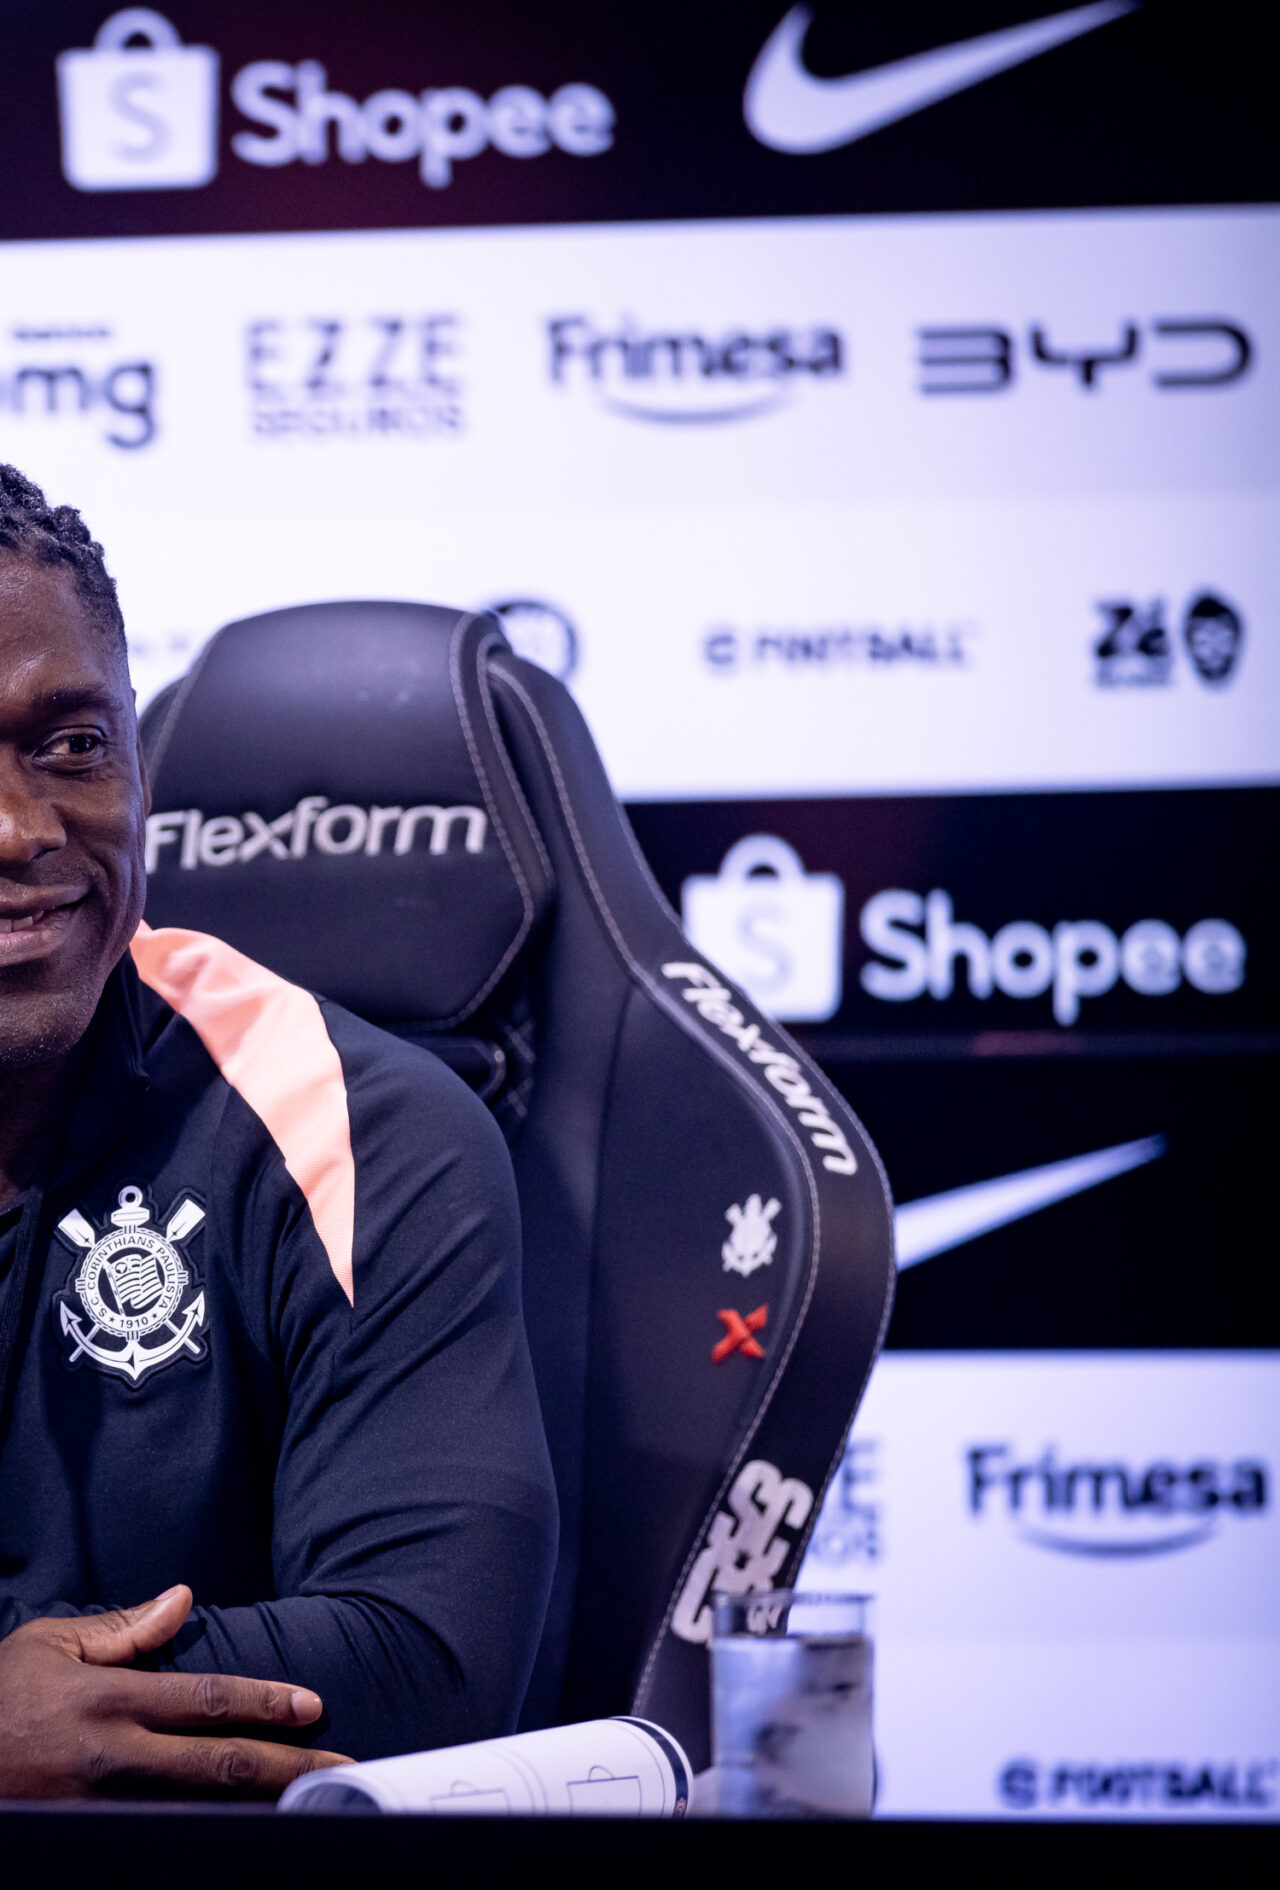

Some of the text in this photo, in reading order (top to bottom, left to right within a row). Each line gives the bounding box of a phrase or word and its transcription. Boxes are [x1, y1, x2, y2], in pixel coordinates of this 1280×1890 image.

[231, 59, 616, 188] Shopee
[548, 312, 844, 385] Frimesa
[917, 315, 1253, 396] BYD
[144, 796, 487, 873] Flexform
[860, 888, 1247, 1027] Shopee
[662, 962, 858, 1176] Flexform
[87, 1235, 156, 1290] CORINTHIANS
[156, 1247, 177, 1310] PAULISTA
[119, 1315, 150, 1328] 1910
[966, 1440, 1269, 1518] Frimesa
